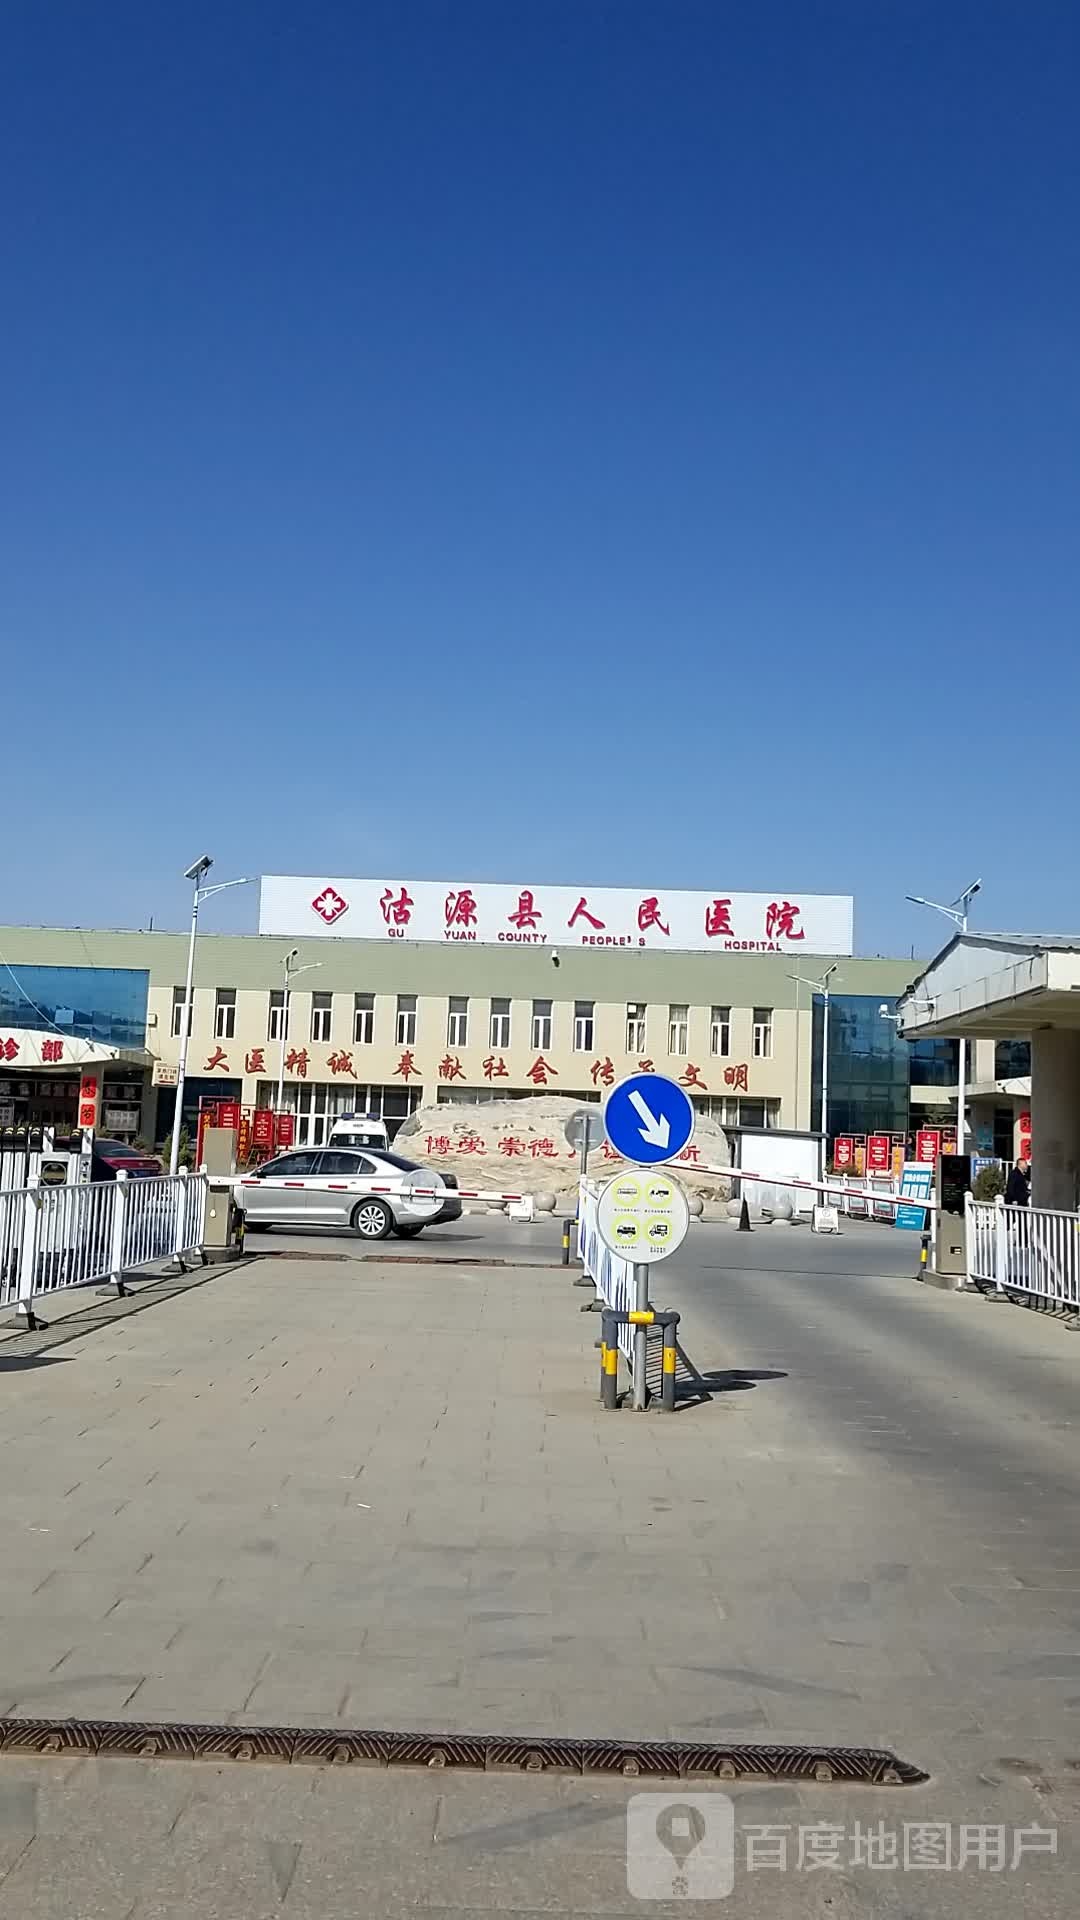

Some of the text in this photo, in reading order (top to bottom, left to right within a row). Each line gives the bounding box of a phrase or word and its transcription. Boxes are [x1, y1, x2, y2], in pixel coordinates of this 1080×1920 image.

[379, 887, 805, 940] 沽源县人民医院
[388, 928, 404, 938] GU
[444, 930, 477, 941] YUAN
[498, 932, 547, 943] COUNTY
[724, 940, 782, 952] HOSPITAL
[203, 1046, 359, 1080] 大医精诚
[392, 1050, 558, 1085] 奉献社会
